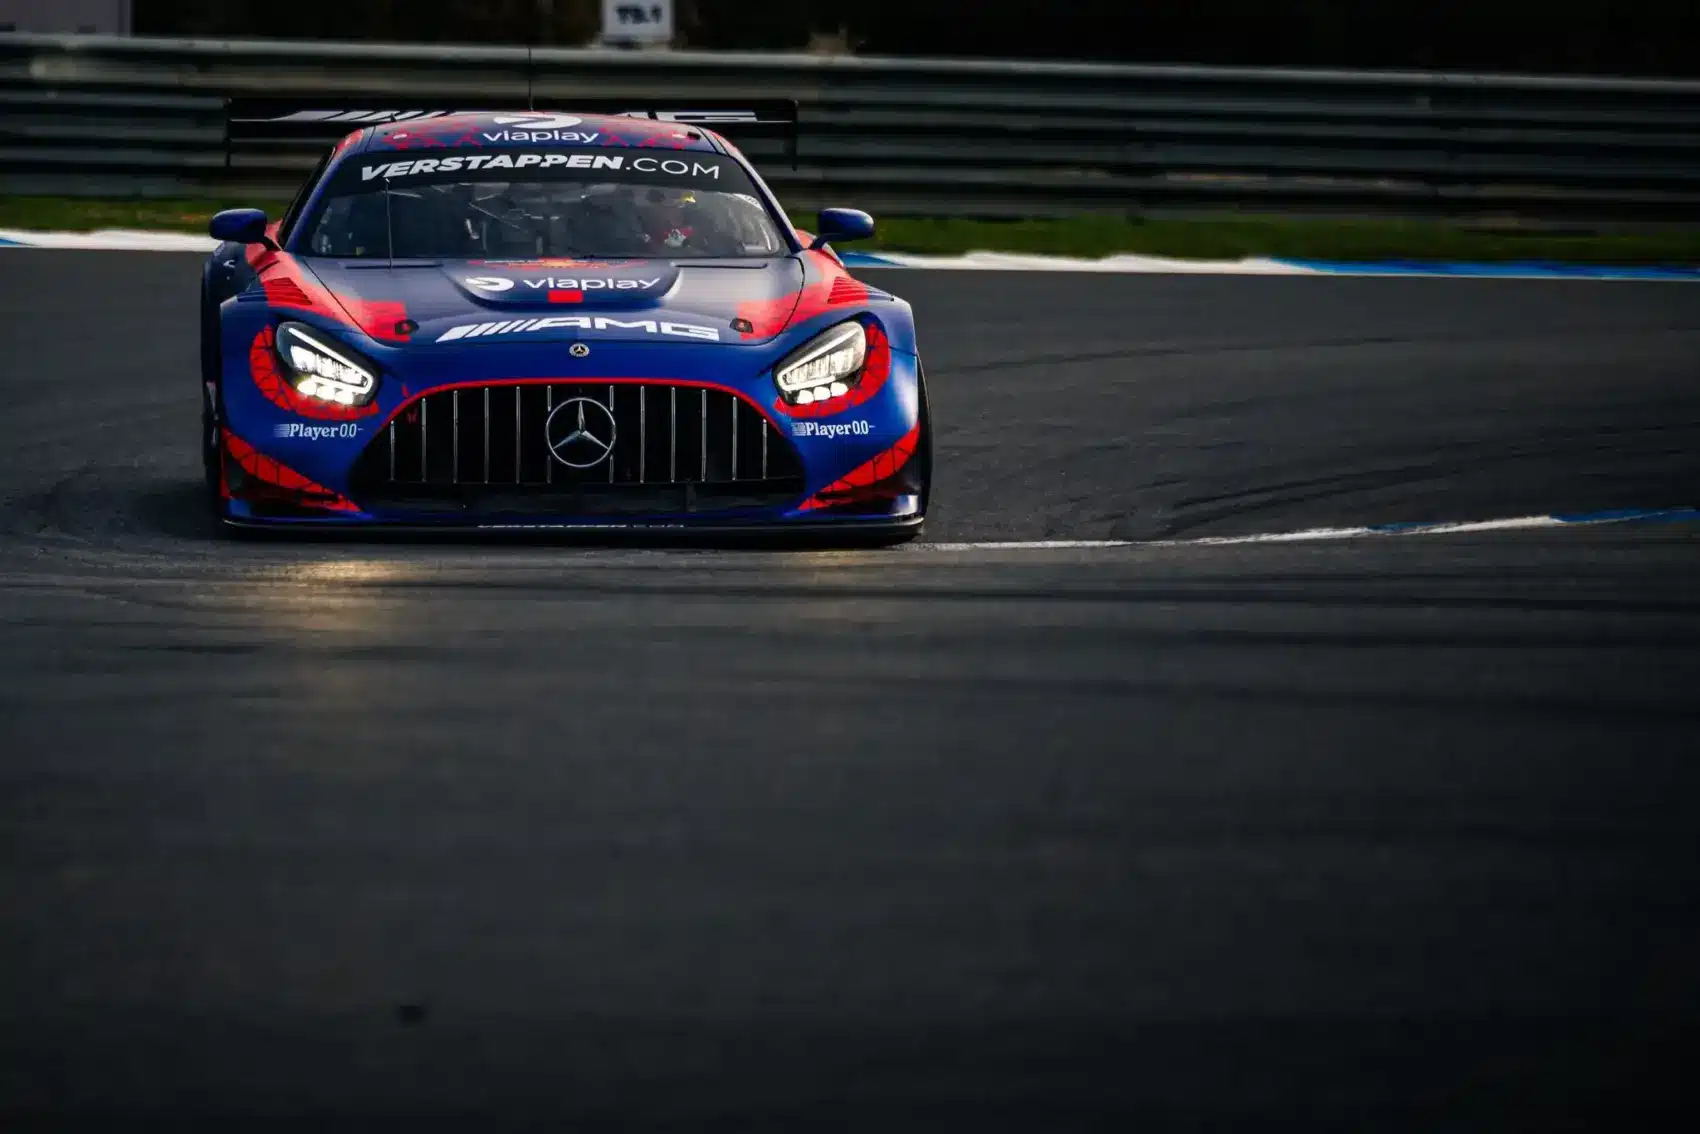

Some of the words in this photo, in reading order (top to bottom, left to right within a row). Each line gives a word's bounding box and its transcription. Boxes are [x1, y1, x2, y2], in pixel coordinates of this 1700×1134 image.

[482, 130, 600, 143] viaplay
[361, 154, 720, 181] VERSTAPPEN.COM
[522, 277, 661, 291] viaplay
[525, 316, 720, 342] AMG
